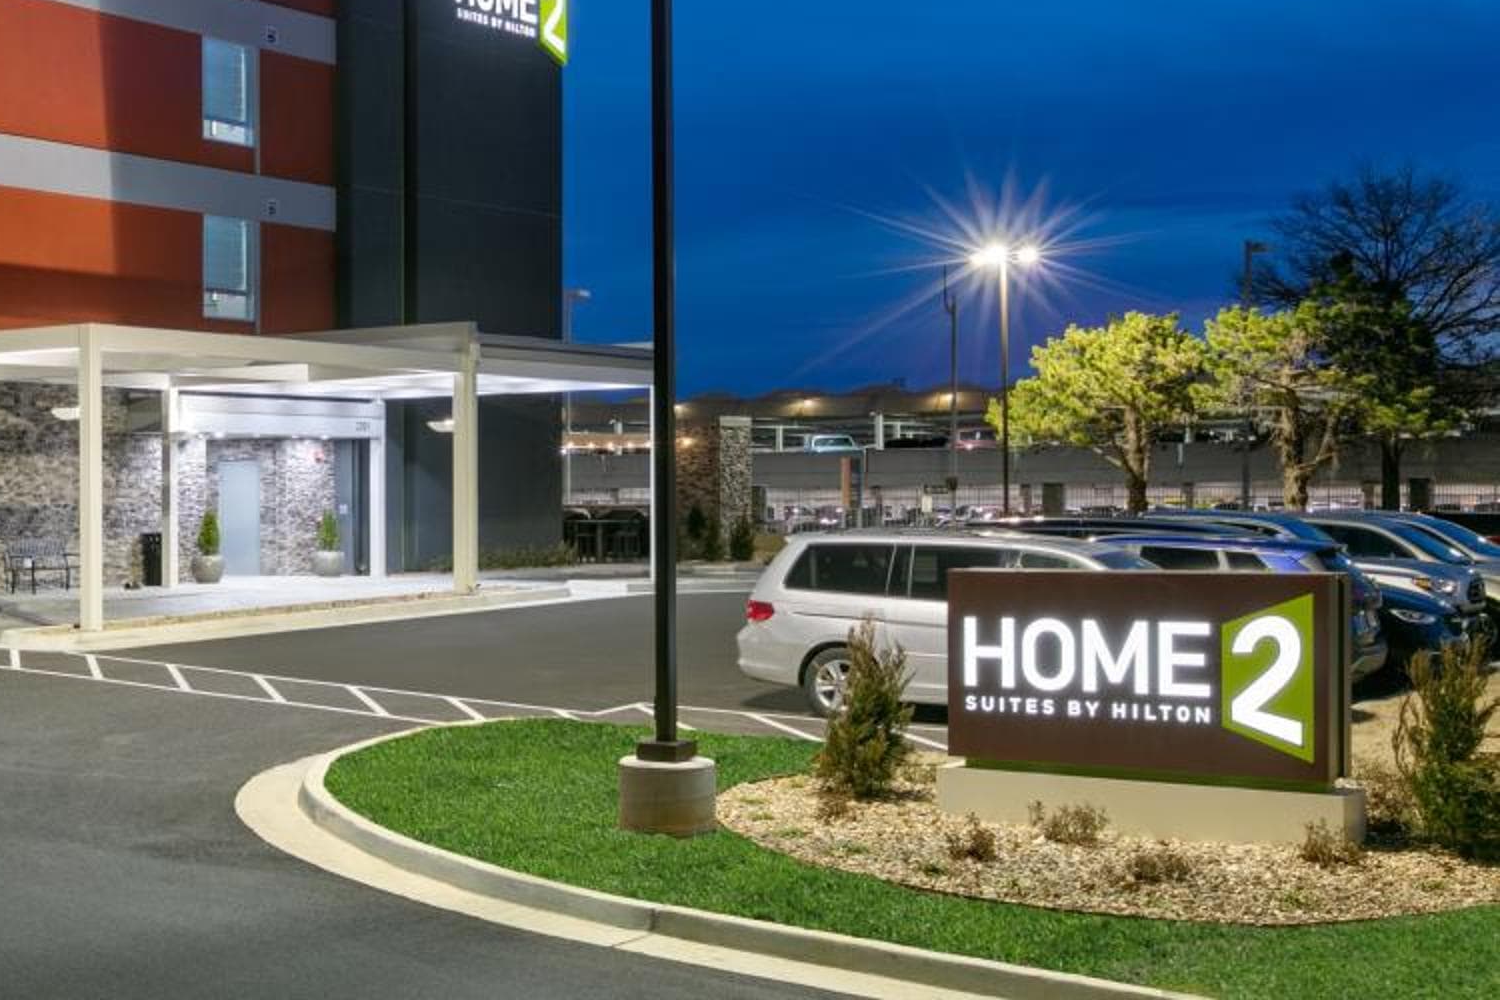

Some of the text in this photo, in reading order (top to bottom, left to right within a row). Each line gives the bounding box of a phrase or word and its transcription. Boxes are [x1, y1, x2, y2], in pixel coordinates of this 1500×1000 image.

[963, 614, 1304, 747] HOME 2
[965, 696, 1212, 724] SUITES BY HILTON
